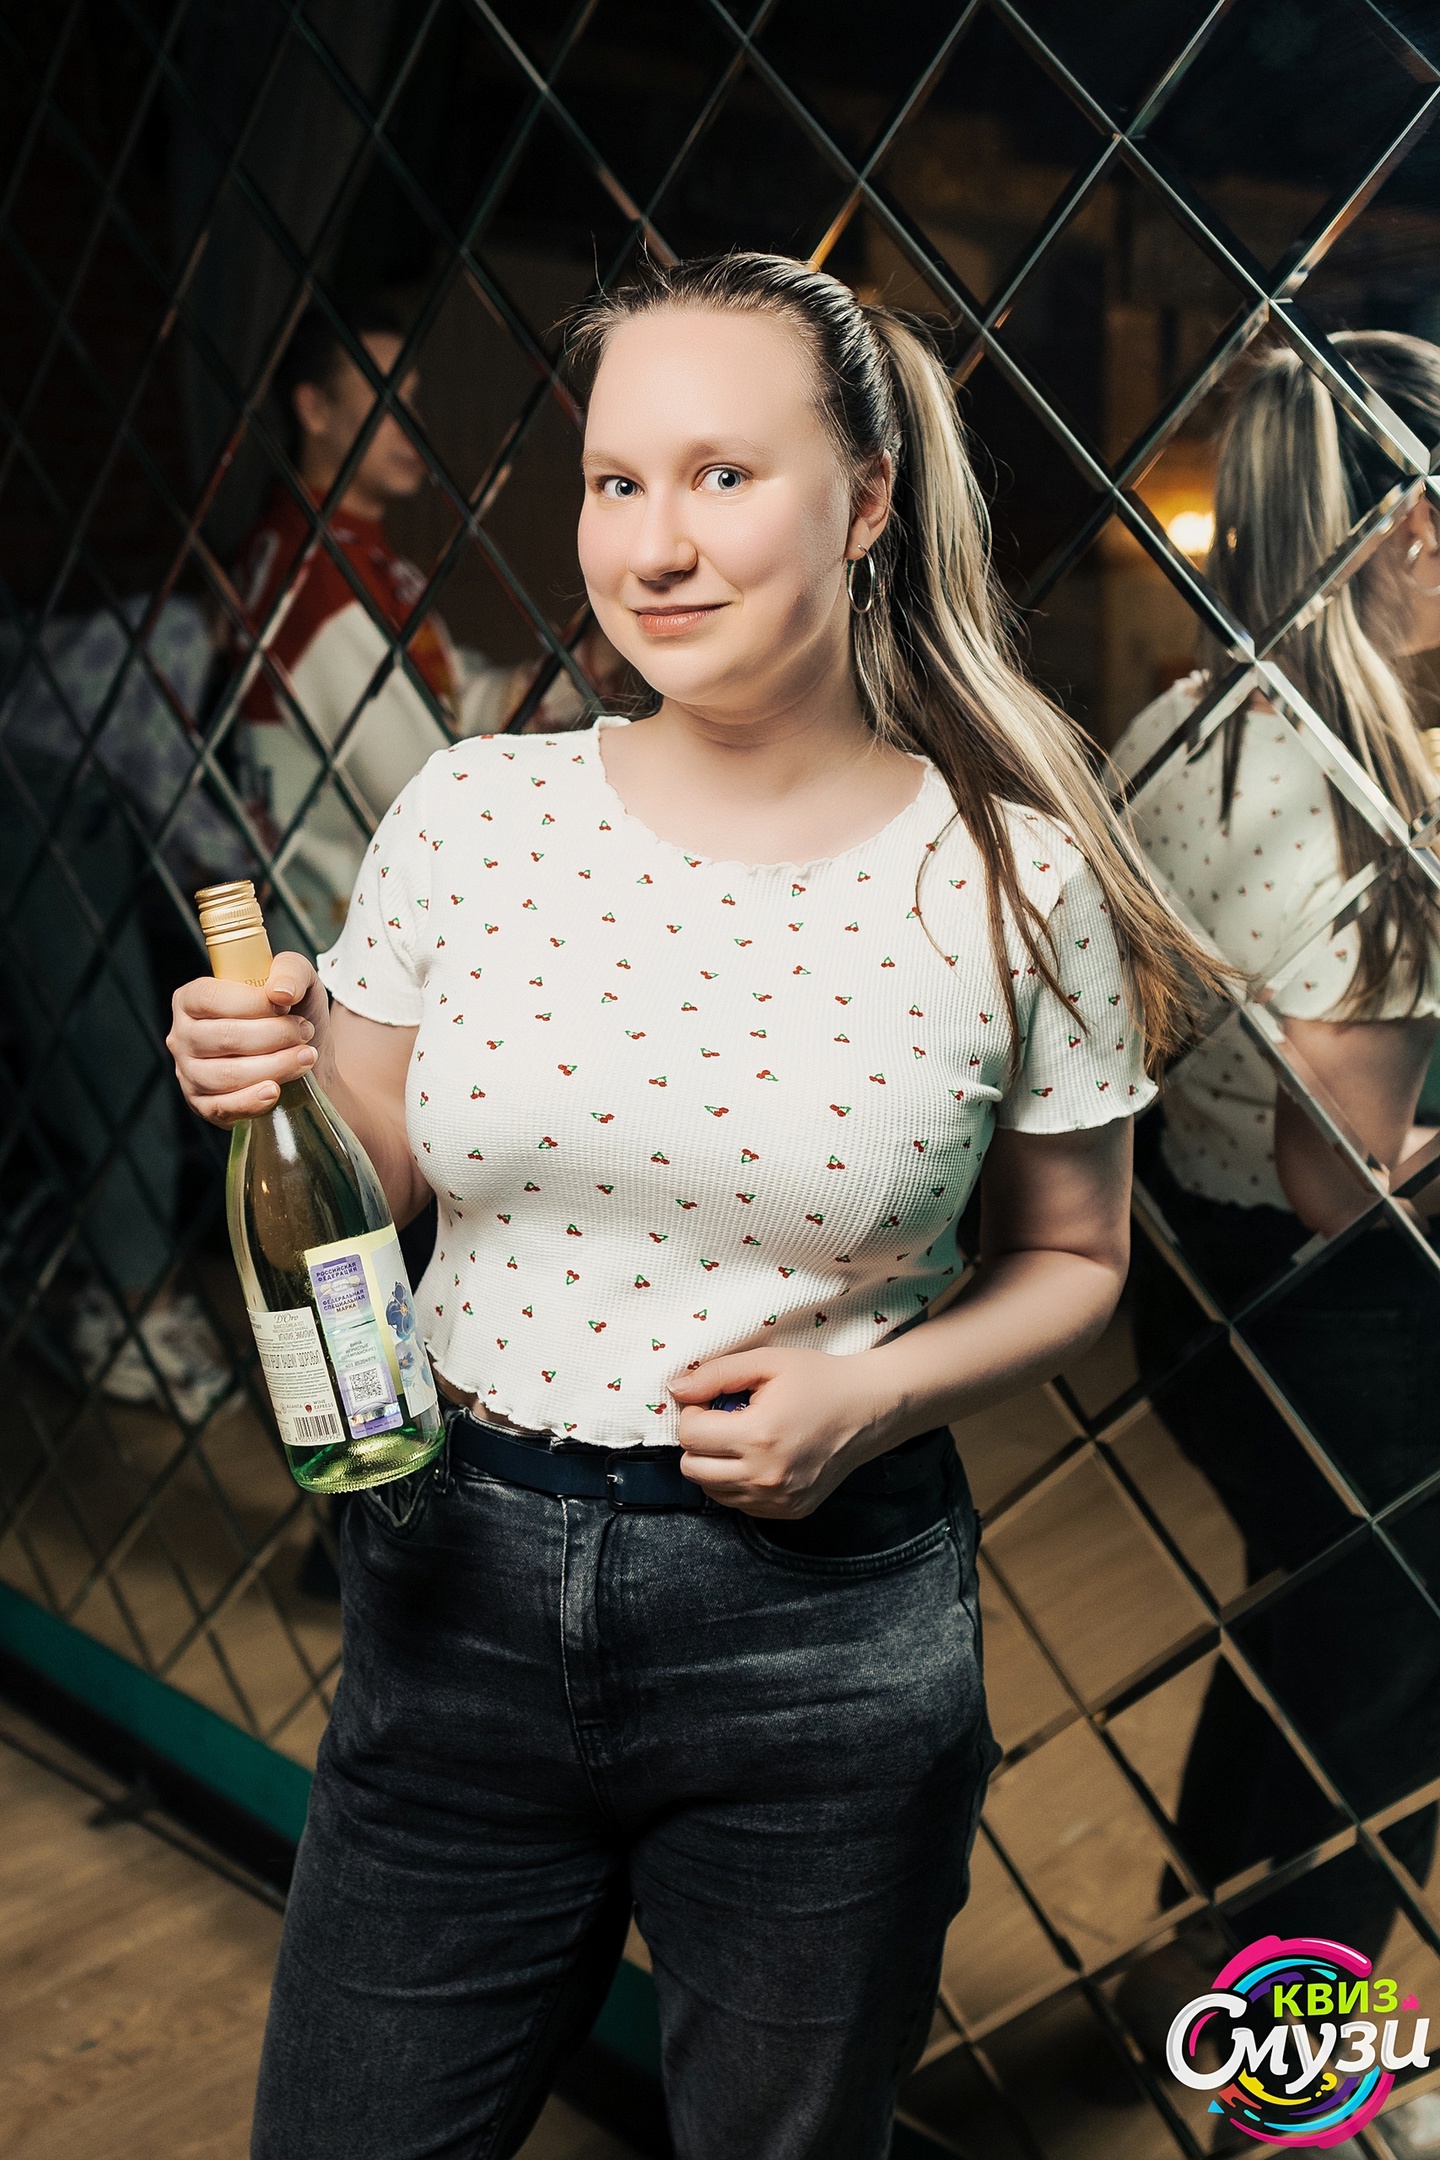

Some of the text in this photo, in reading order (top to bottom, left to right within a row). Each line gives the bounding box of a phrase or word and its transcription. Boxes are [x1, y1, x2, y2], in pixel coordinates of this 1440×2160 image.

[316, 1262, 357, 1277] РОССИЙСКАЯ
[318, 1267, 358, 1282] ФЕДЕРАЦИЯ
[323, 1289, 364, 1306] ФЕДЕРАЛЬНАЯ
[324, 1295, 366, 1311] СПЕЦИАЛЬНАЯ
[336, 1303, 357, 1313] МАРКА
